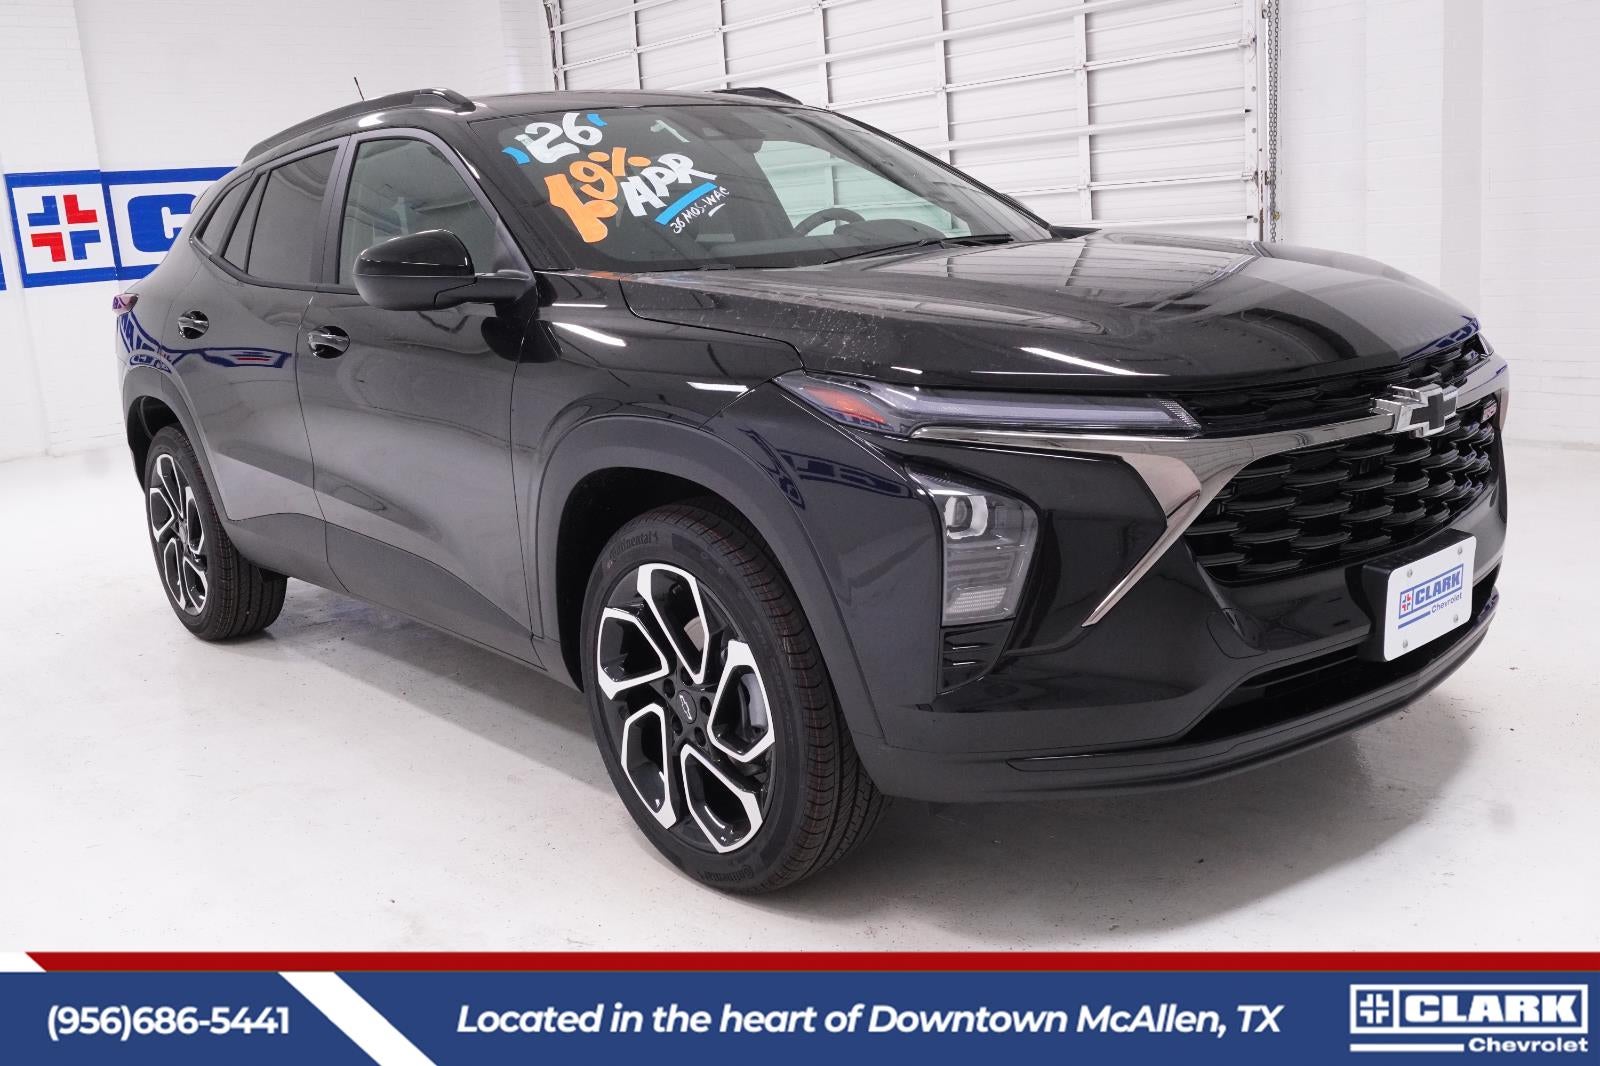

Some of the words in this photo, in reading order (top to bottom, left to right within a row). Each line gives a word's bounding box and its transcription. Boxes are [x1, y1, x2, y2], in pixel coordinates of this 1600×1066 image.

[619, 153, 718, 217] APR
[1414, 571, 1461, 606] CLARK
[1431, 592, 1463, 613] Chevrolet
